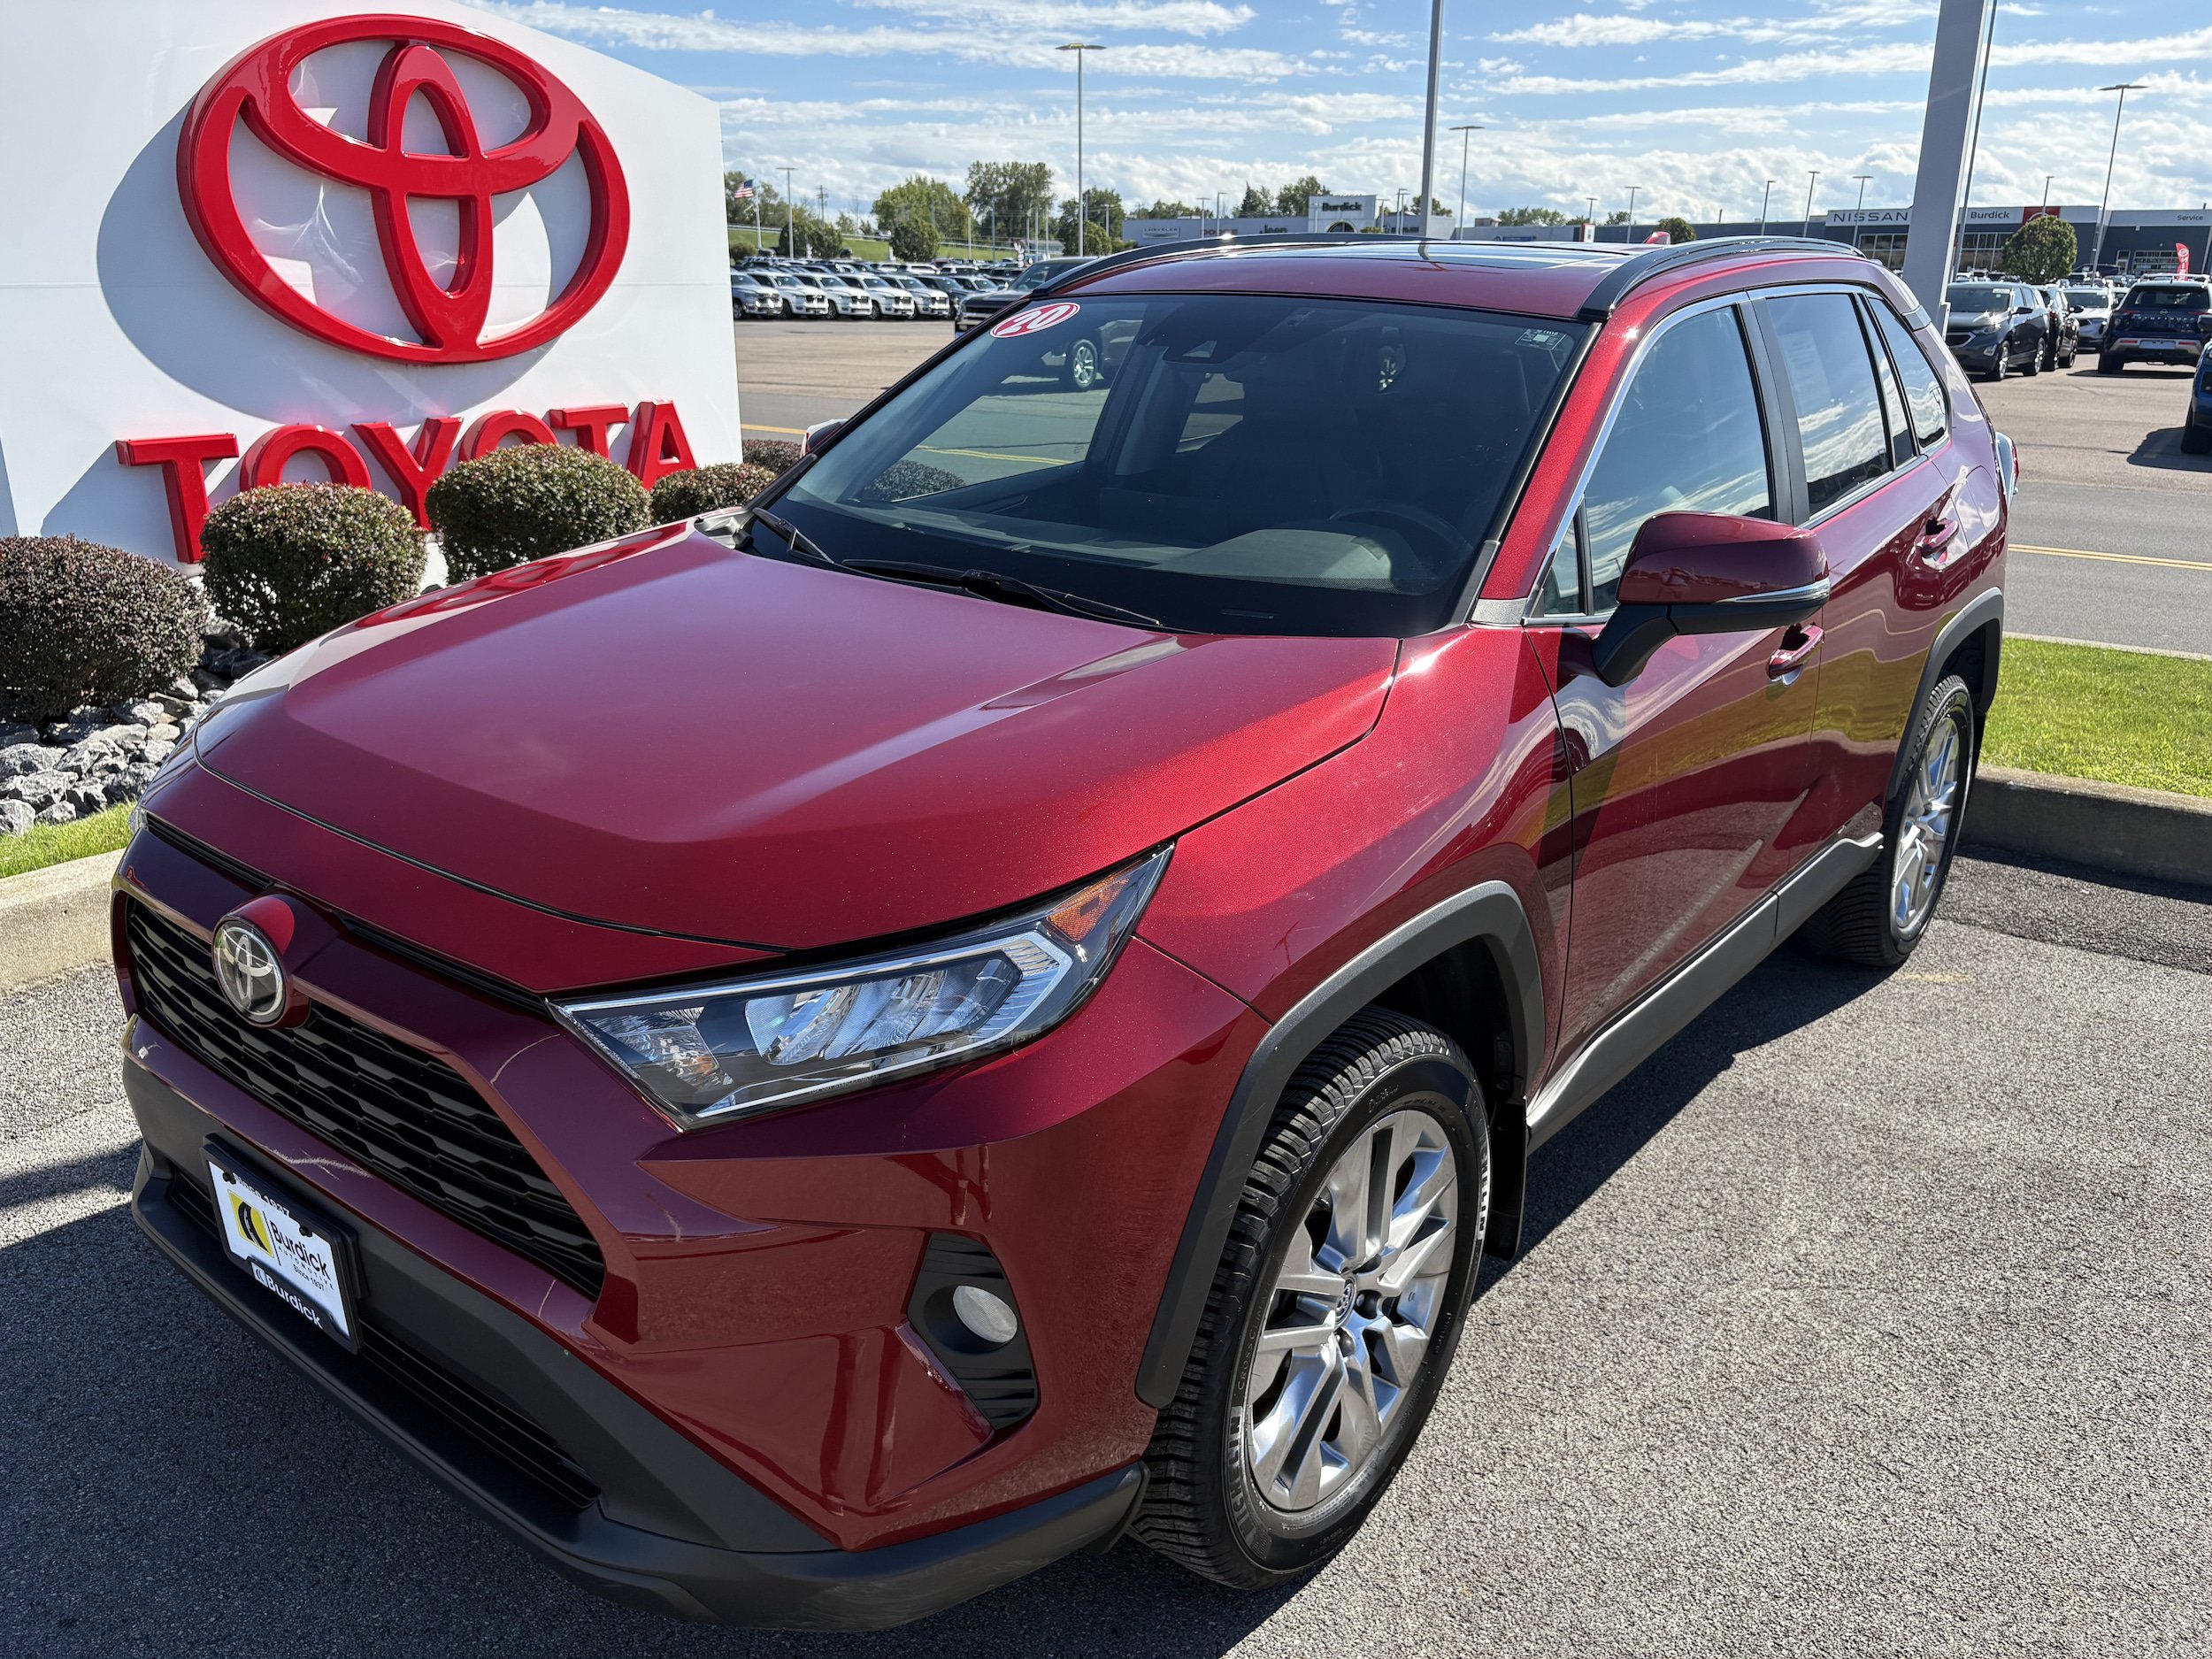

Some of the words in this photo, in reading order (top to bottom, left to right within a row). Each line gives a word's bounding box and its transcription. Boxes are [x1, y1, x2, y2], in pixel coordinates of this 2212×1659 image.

[1833, 211, 1909, 222] NISSAN
[996, 303, 1071, 336] 20
[115, 399, 697, 565] TOYTA
[269, 1220, 332, 1281] Burdick
[266, 1273, 324, 1329] Burdick
[1228, 1416, 1255, 1540] MICHELIN
